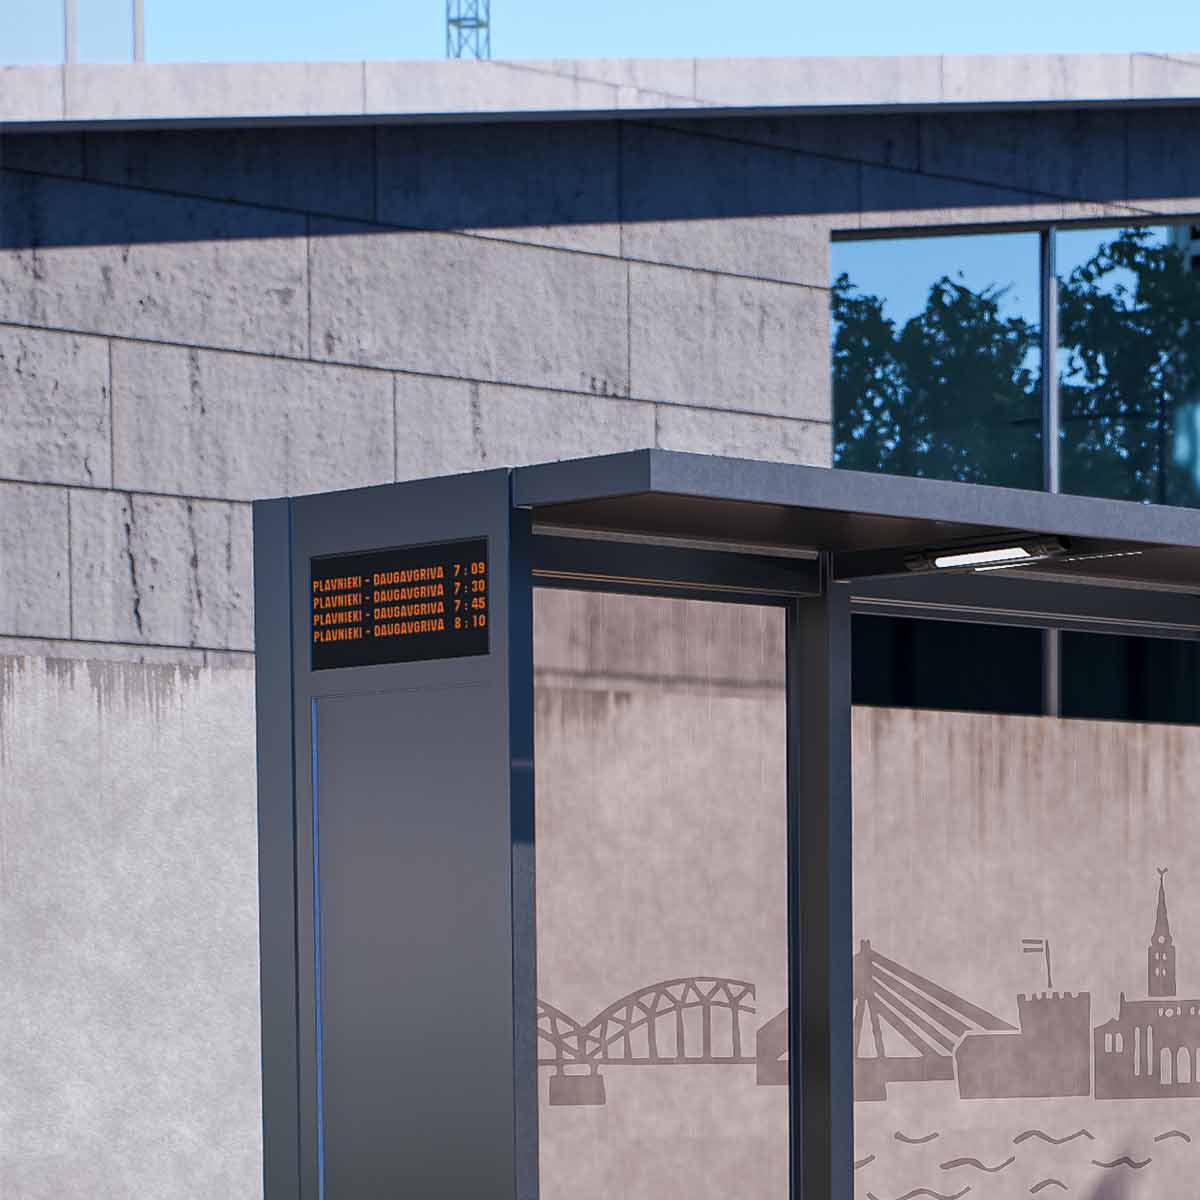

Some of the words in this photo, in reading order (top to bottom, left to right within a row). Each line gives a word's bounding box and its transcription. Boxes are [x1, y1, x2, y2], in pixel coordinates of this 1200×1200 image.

[313, 576, 362, 592] PLAVNIEKI
[373, 566, 444, 586] DAUGAVGRIVA
[313, 593, 362, 609] PLAVNIEKI
[373, 583, 444, 604] DAUGAVGRIVA
[313, 609, 362, 626] PLAVNIEKI
[373, 601, 444, 621] DAUGAVGRIVA
[313, 626, 362, 642] PLAVNIEKI
[373, 618, 444, 637] DAUGAVGRIVA
